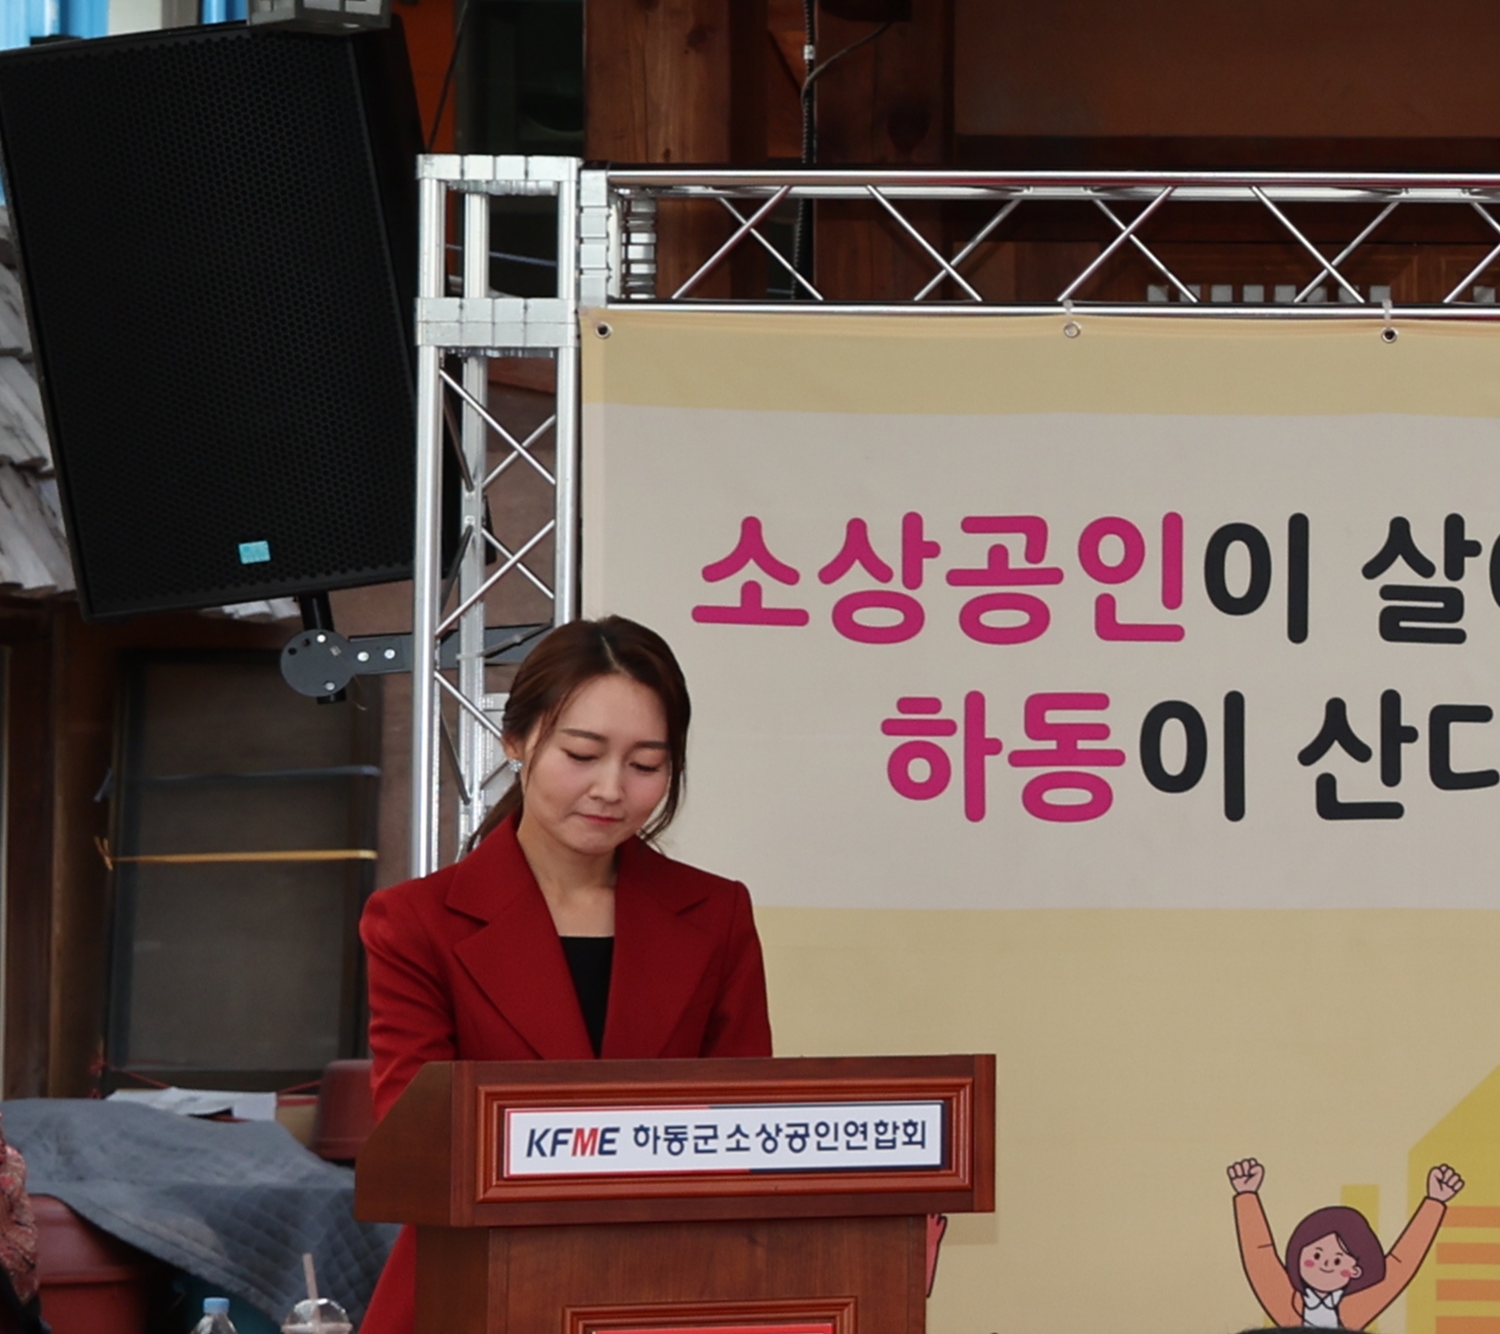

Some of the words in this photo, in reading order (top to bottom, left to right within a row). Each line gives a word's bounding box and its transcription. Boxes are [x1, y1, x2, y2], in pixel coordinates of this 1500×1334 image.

[691, 510, 1310, 647] 소상공인이
[881, 692, 1245, 822] 하동이
[526, 1127, 619, 1157] KFME
